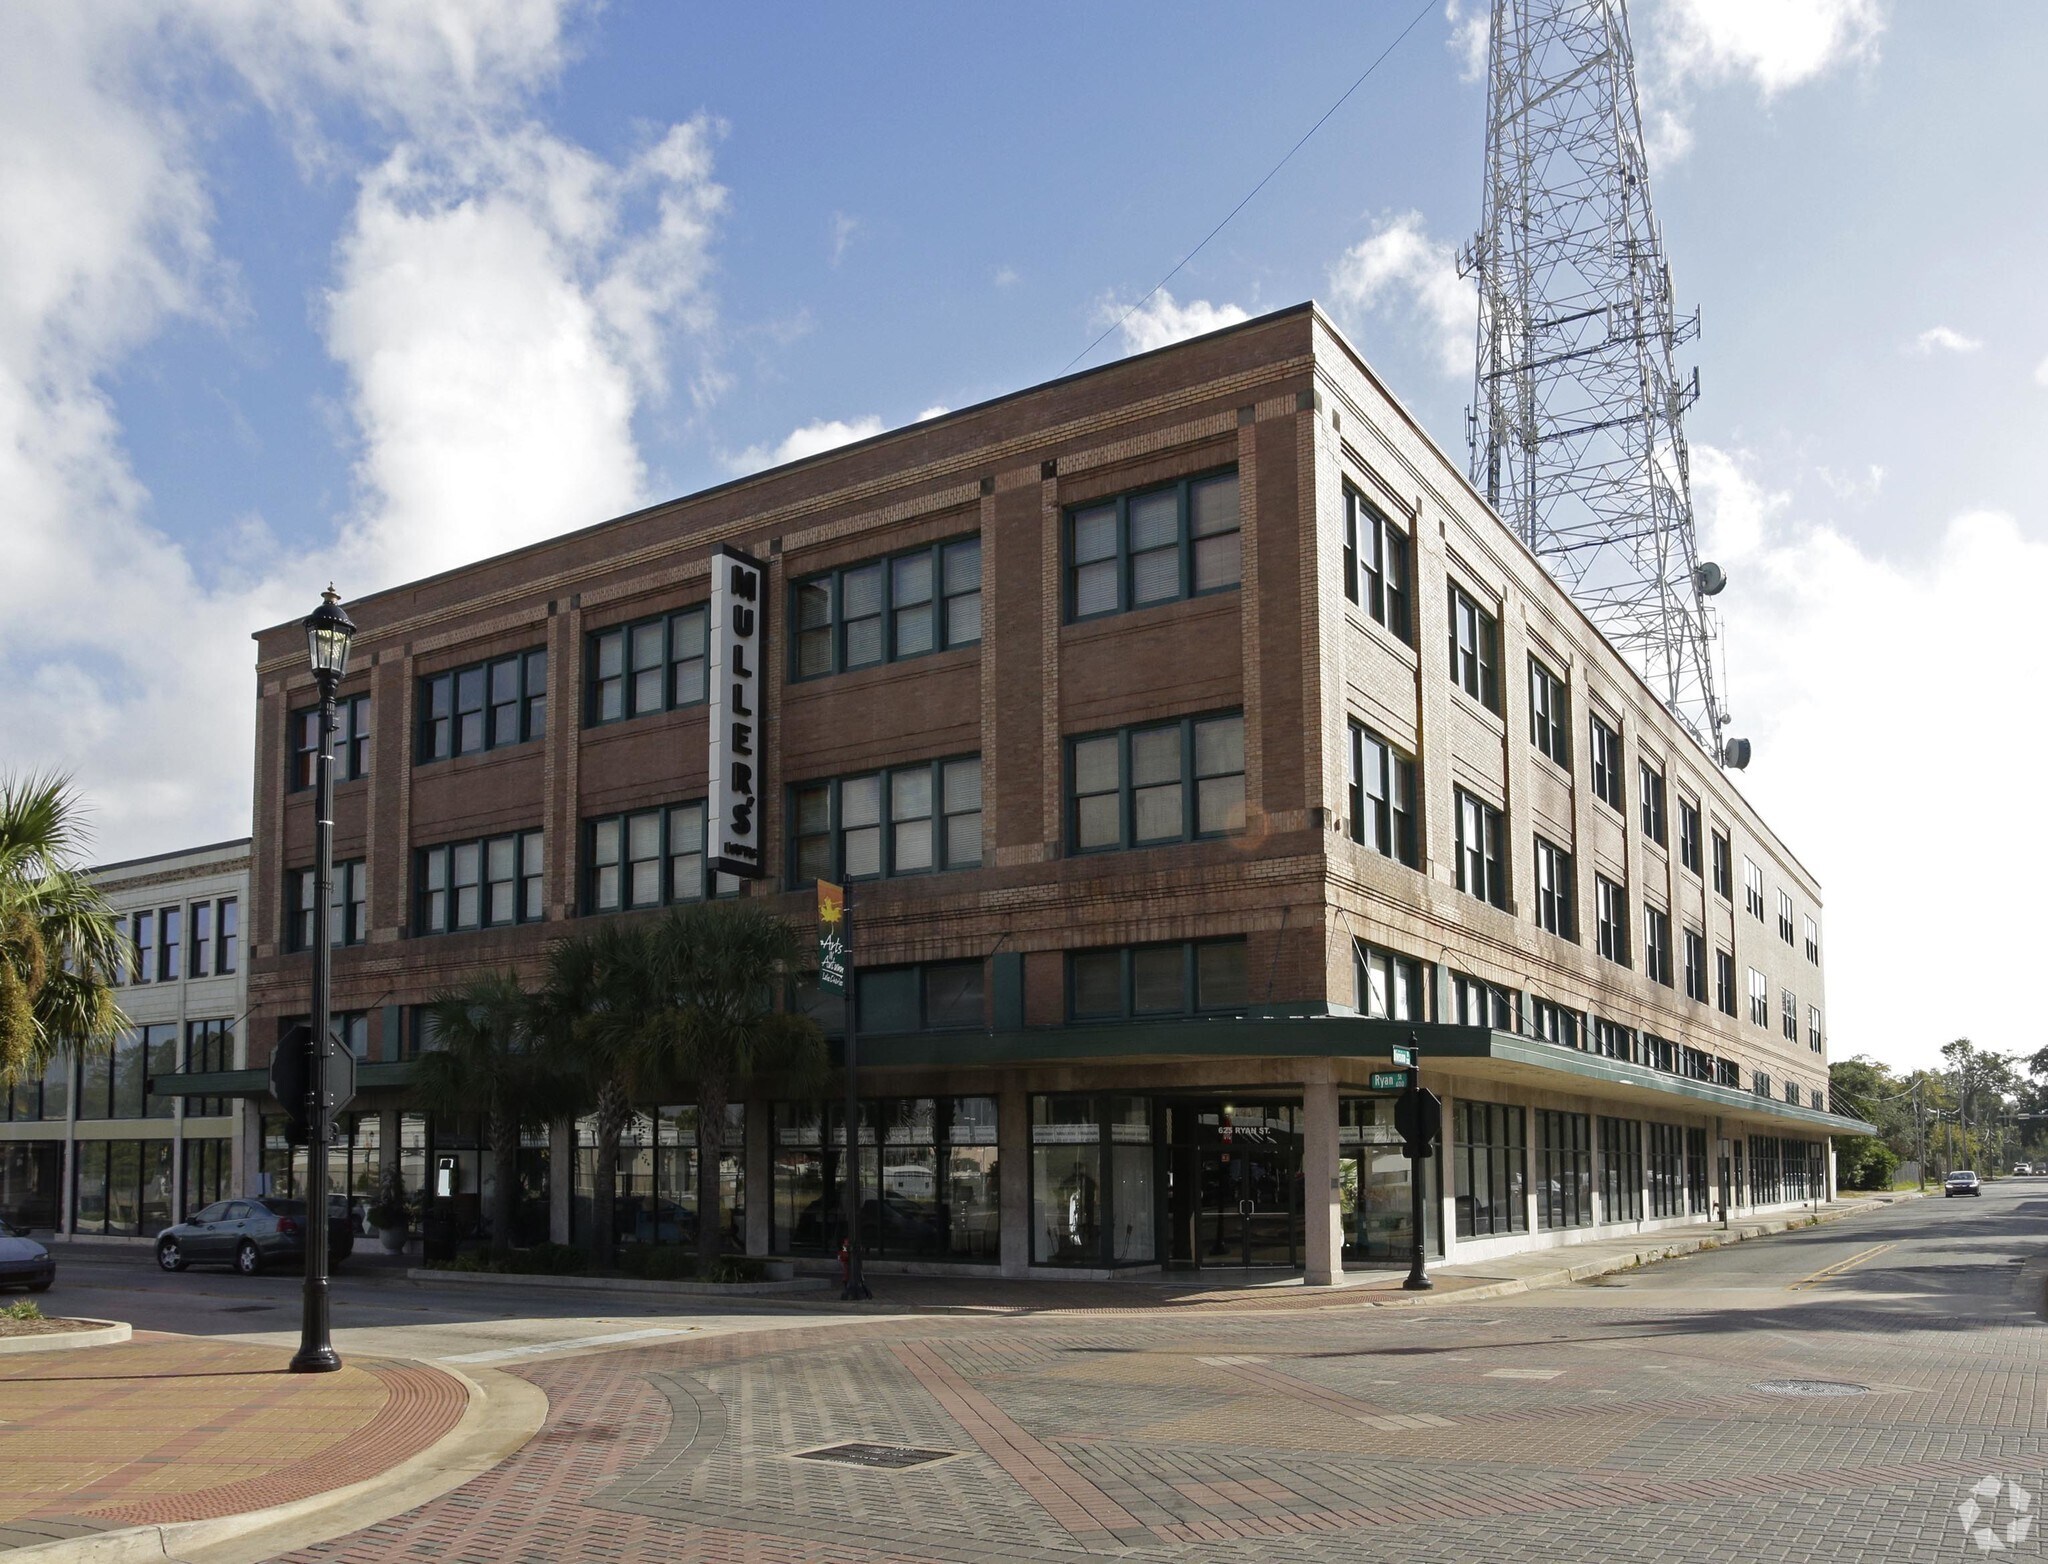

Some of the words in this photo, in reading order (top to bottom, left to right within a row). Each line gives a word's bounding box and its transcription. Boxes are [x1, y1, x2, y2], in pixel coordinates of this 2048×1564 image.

[731, 564, 757, 836] MULLER'S
[820, 934, 843, 954] Arts
[1374, 1074, 1394, 1089] Ryan
[1218, 1126, 1233, 1134] 625
[1235, 1126, 1257, 1135] RYAN
